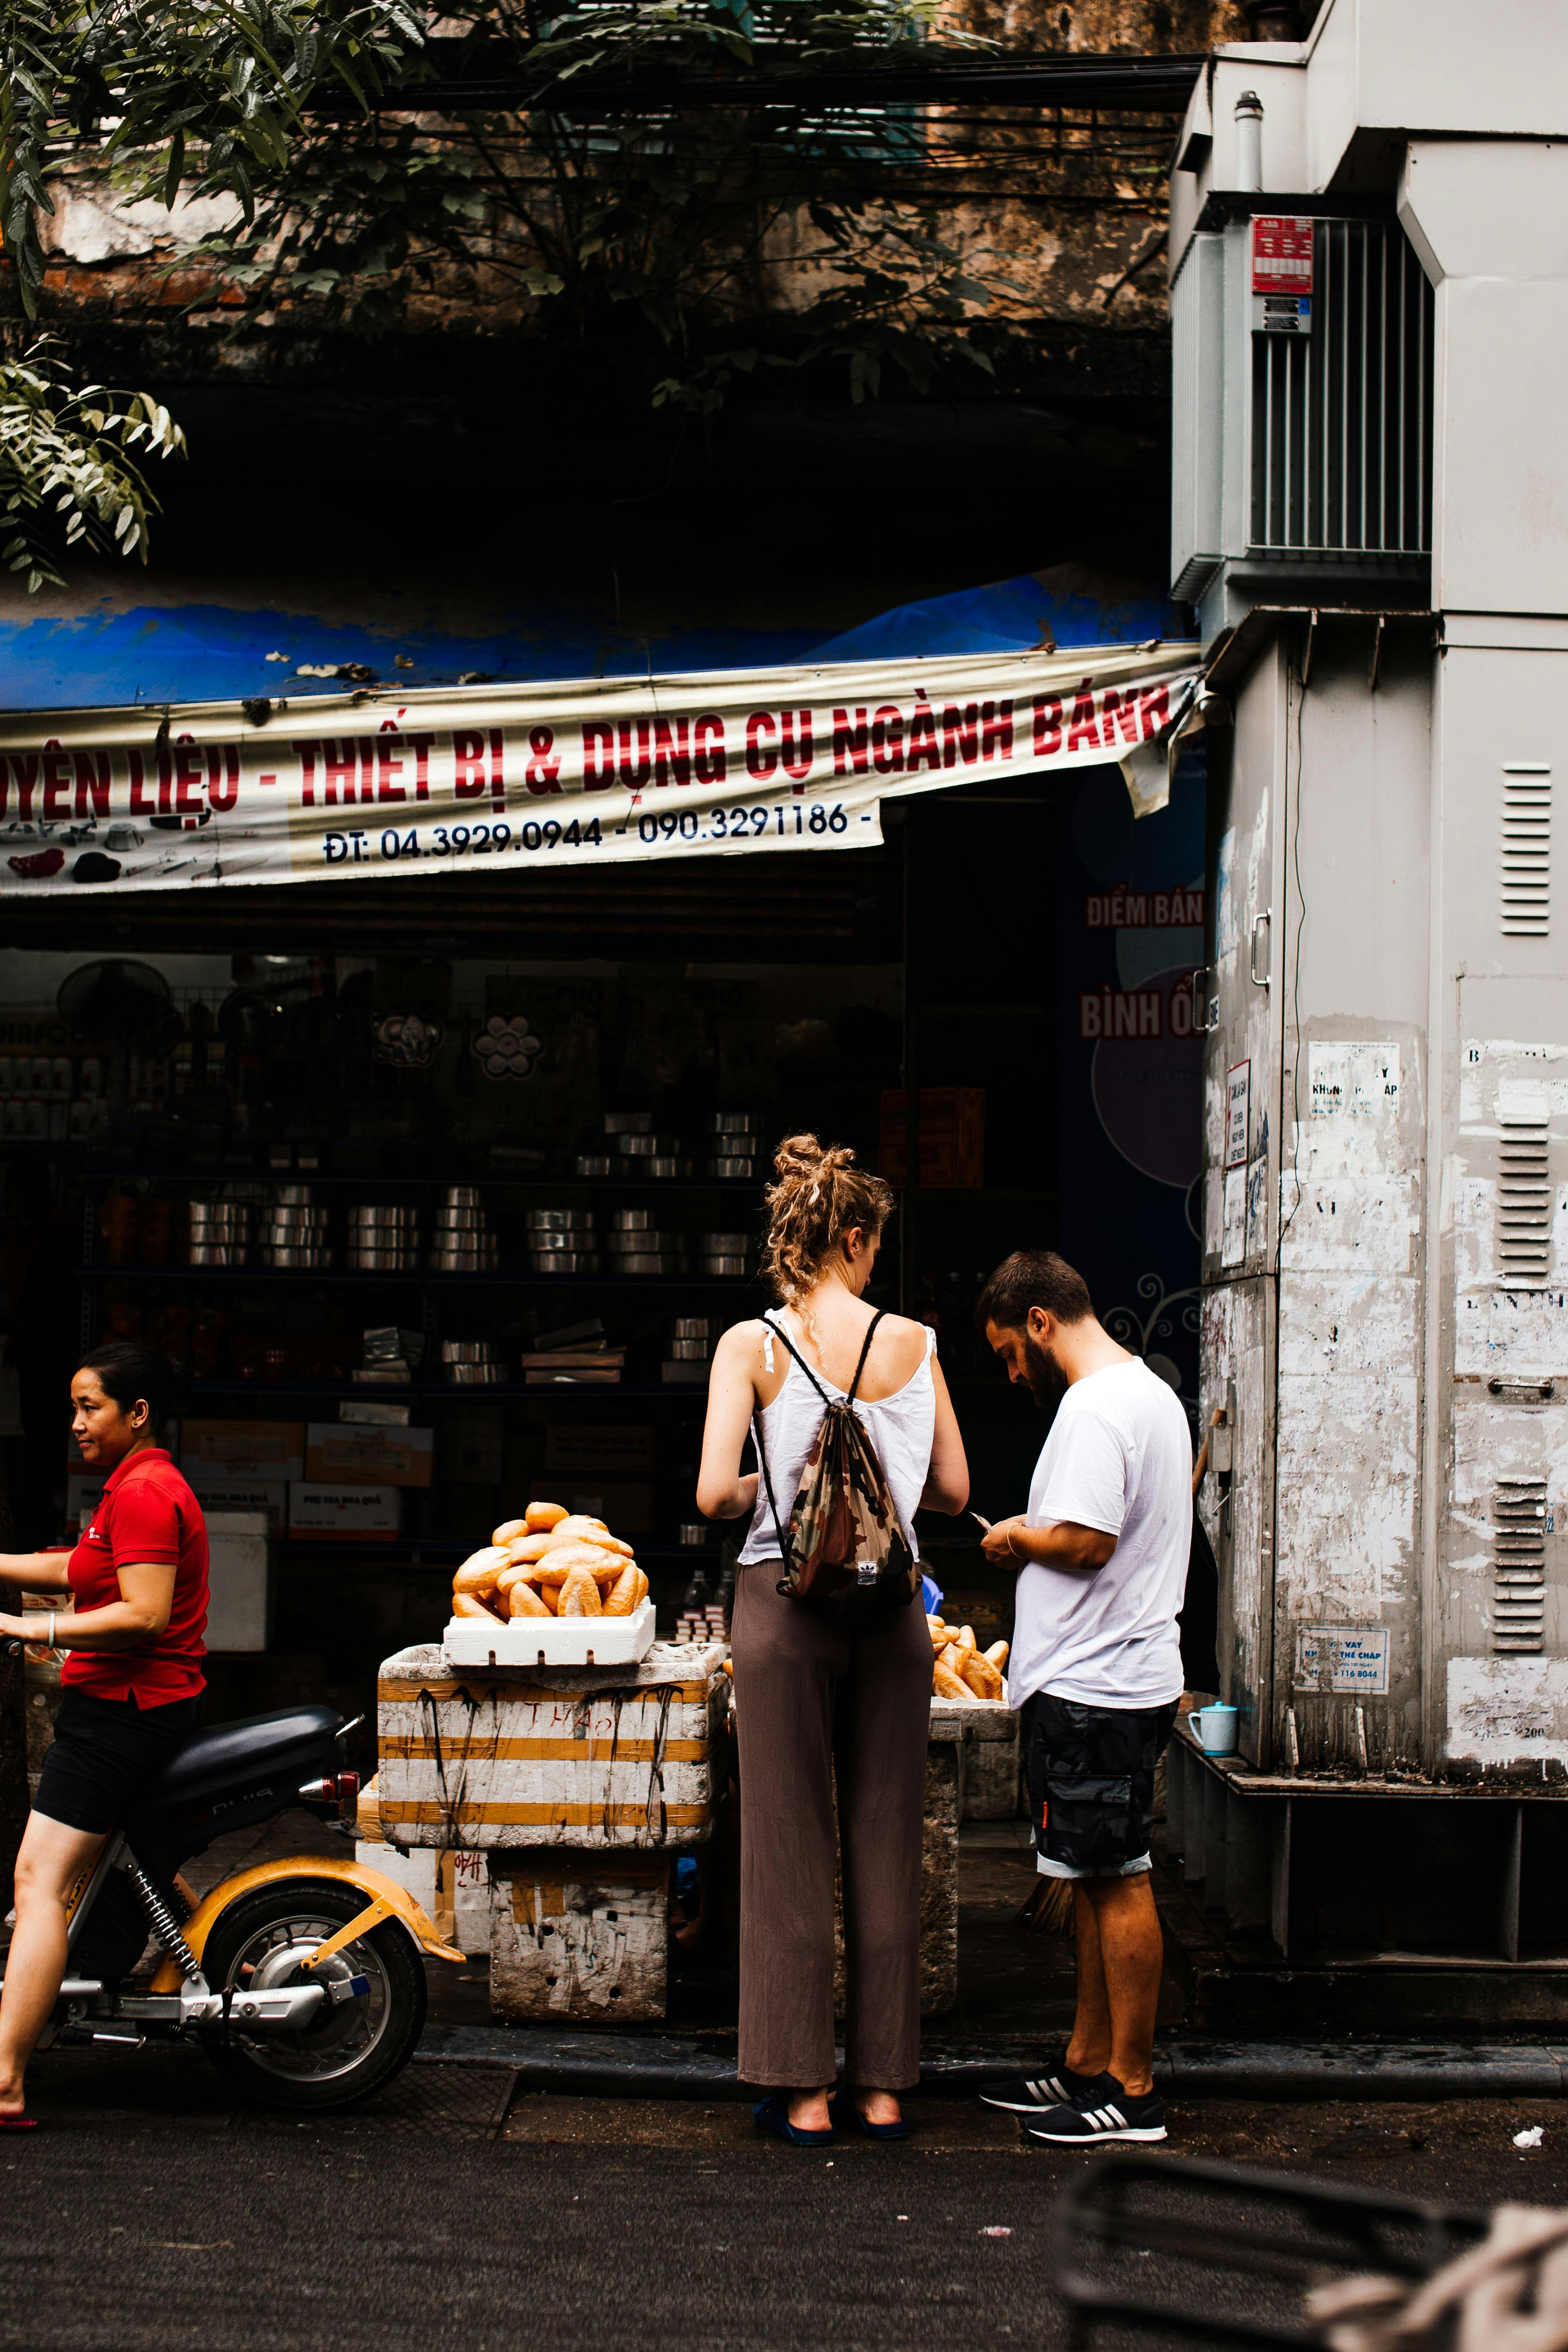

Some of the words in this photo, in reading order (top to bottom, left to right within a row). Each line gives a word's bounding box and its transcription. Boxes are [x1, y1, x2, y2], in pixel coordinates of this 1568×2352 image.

[0, 737, 112, 822] YÊN
[128, 733, 240, 830] LIỆU
[291, 708, 436, 806] THIẾT
[453, 728, 505, 813] BỊ
[525, 725, 563, 795] &
[581, 713, 727, 804] DỤNG
[745, 711, 813, 795] CỤ
[832, 688, 1014, 776] NGÀNH
[1033, 677, 1170, 756] BÁNH
[323, 831, 369, 863] ĐT:
[380, 817, 603, 860] 04.3929.0944
[638, 803, 847, 842] 090.3291186
[1087, 882, 1147, 927] ĐIỂM
[1154, 886, 1204, 924] BÁN
[1081, 984, 1160, 1037] BÌNH
[1357, 1670, 1378, 1678] 8044
